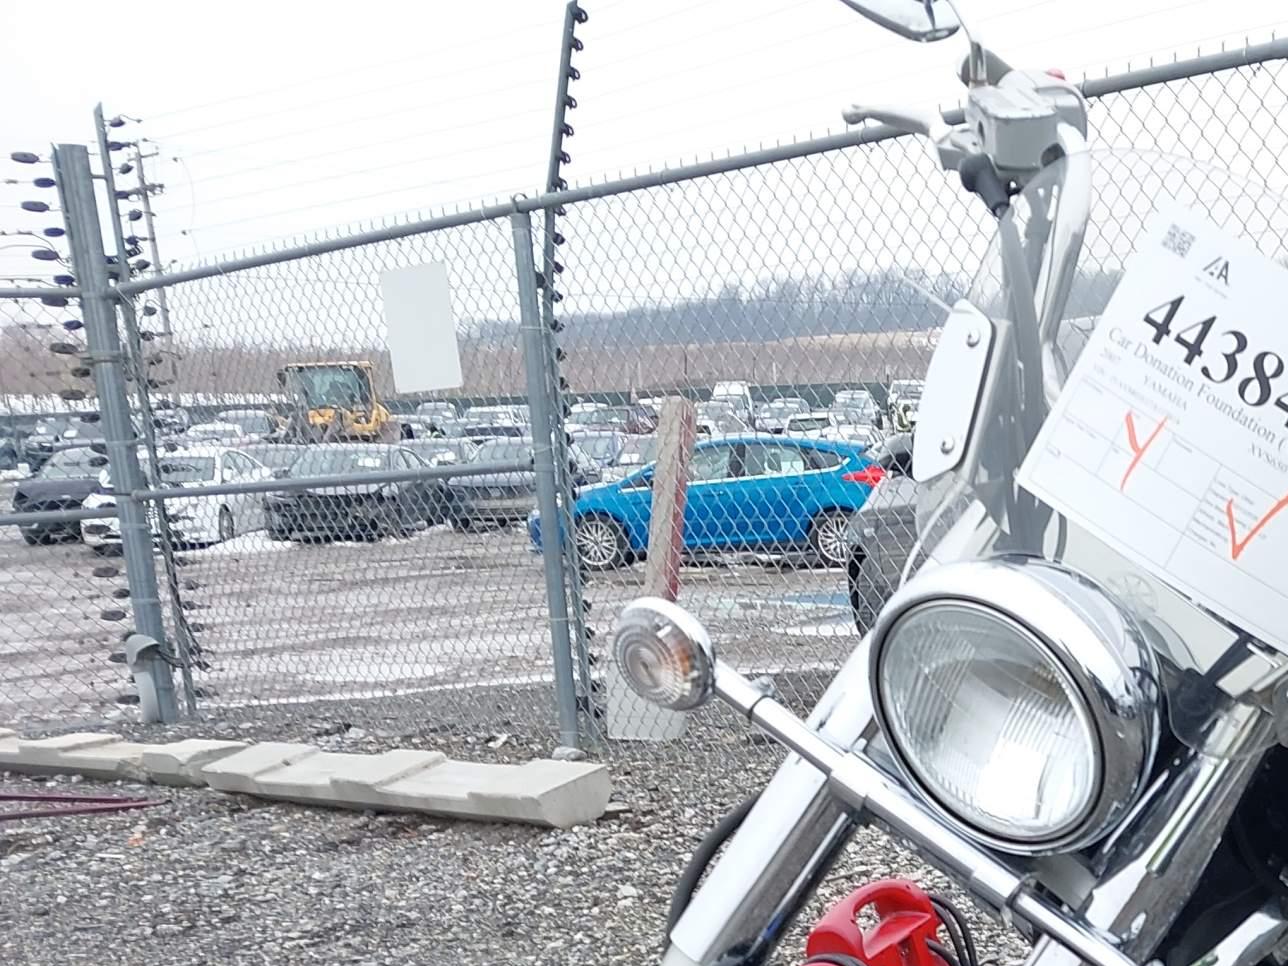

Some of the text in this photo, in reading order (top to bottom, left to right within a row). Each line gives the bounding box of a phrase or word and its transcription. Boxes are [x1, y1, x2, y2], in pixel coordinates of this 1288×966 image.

[1108, 327, 1133, 351] Car
[1134, 342, 1194, 392] Donation
[1197, 383, 1276, 444] Foundation
